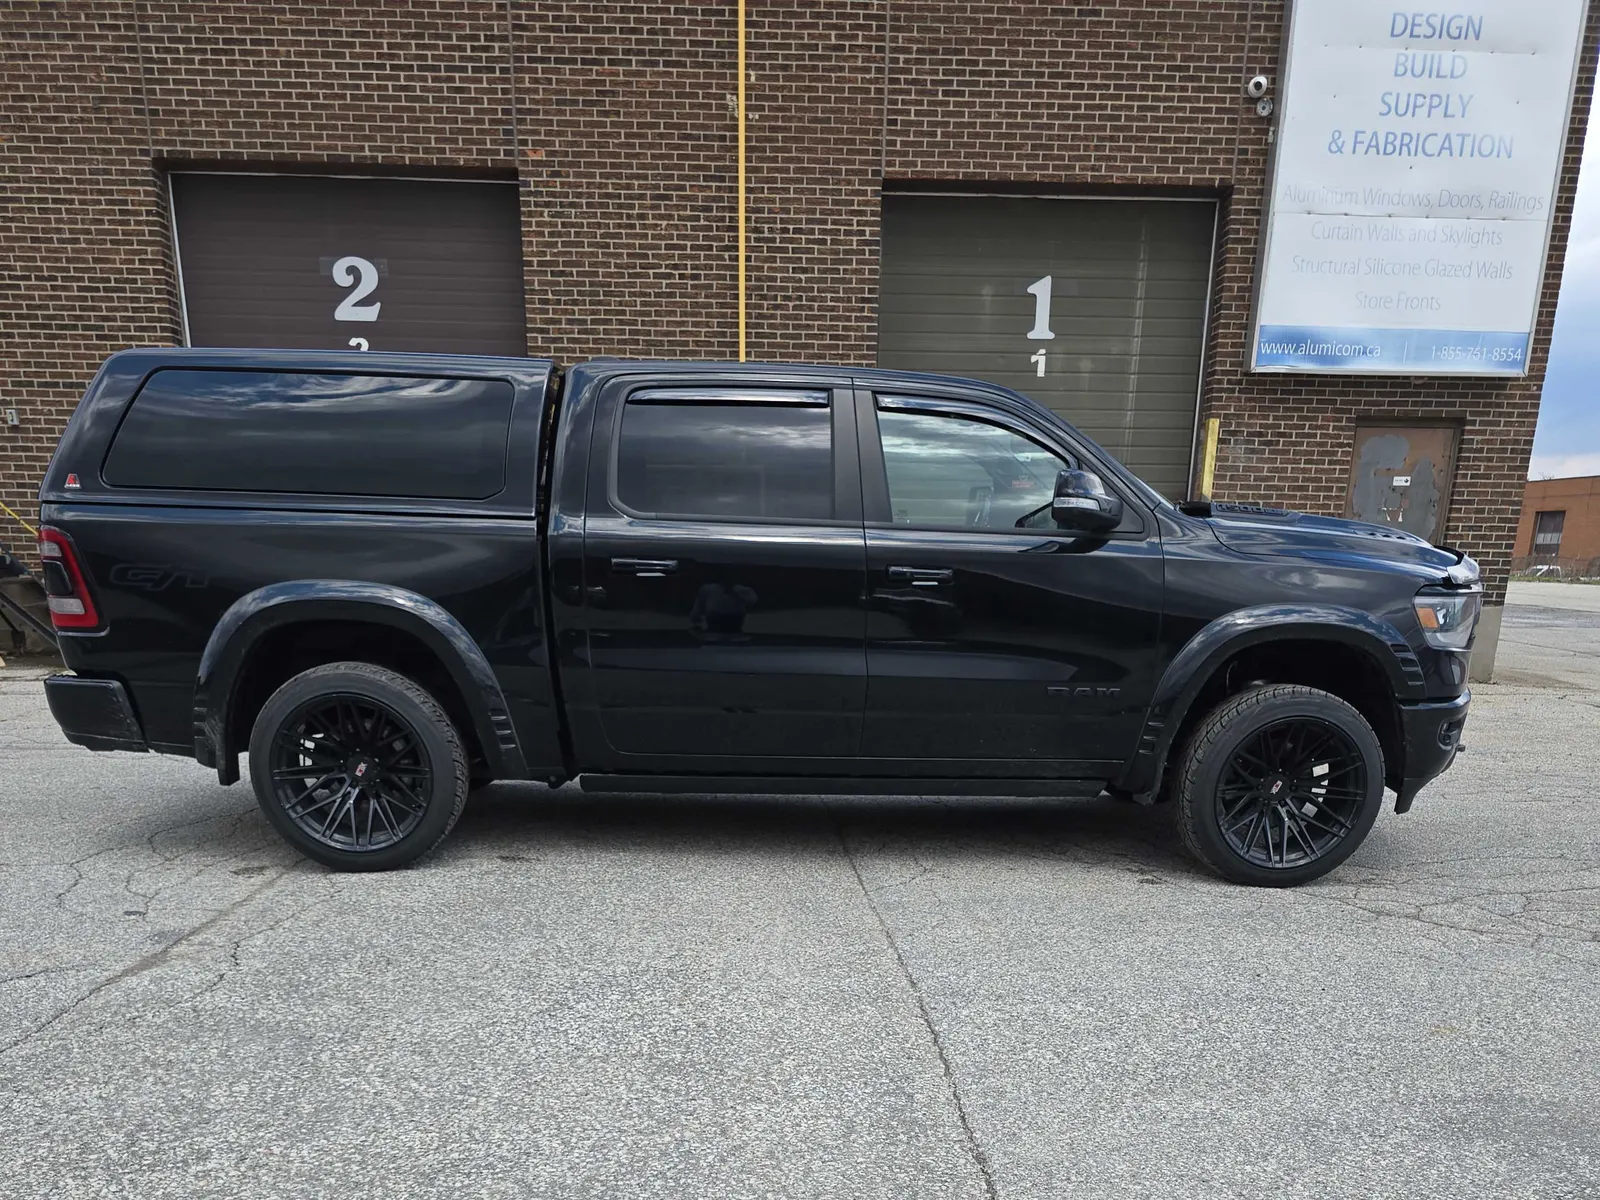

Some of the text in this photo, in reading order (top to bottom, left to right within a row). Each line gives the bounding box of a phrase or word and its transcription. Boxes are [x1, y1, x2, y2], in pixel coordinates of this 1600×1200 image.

[1390, 12, 1483, 41] DESIGN
[1393, 52, 1468, 79] BUILD
[1378, 92, 1475, 118] SUPPLY
[1328, 129, 1514, 158] & FABRICATION
[1283, 186, 1545, 212] Aluminum Windows, Doors, Railings
[1311, 221, 1503, 248] Curtain Walls and Skylights
[1291, 255, 1513, 279] Structural Silicone Glazed Walls
[332, 256, 381, 321] 2
[1355, 291, 1441, 310] Store Fronts
[1027, 275, 1055, 339] 1
[1260, 339, 1381, 357] www.alumicom.ca
[1046, 685, 1121, 698] RAM
